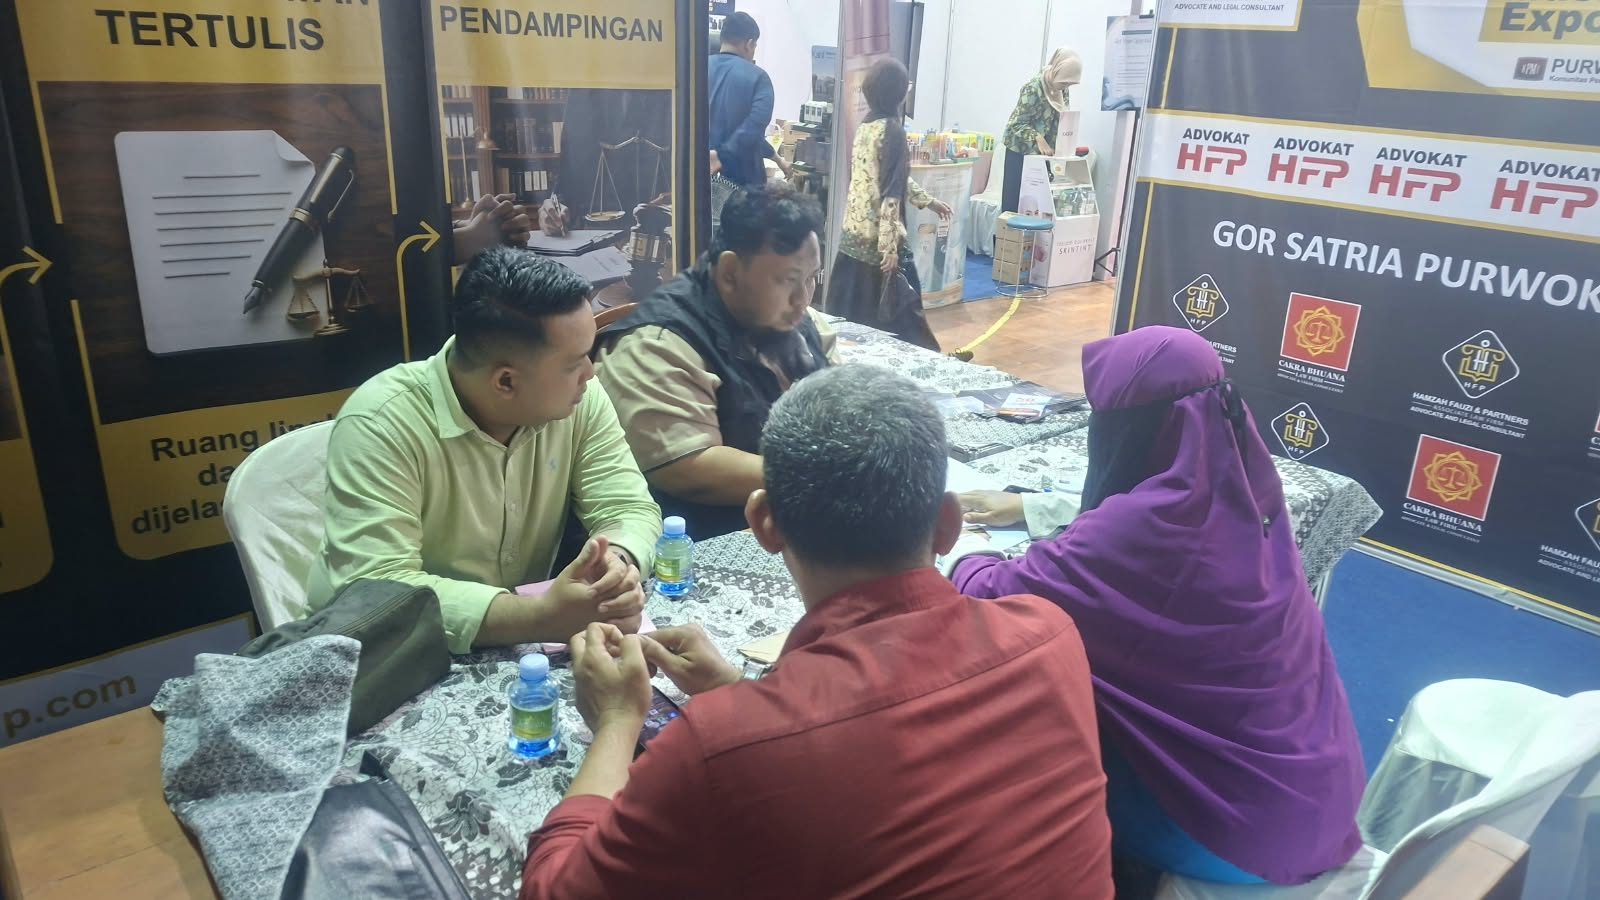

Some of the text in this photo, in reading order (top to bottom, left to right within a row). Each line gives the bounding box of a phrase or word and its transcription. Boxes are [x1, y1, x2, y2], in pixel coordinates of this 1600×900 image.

[95, 9, 324, 50] TERTULIS
[440, 5, 663, 42] PENDAMPINGAN
[1183, 128, 1250, 145] ADVOKAT
[1274, 137, 1354, 156] ADVOKAT
[1176, 143, 1248, 175] HFP
[1267, 153, 1350, 188] HFP
[1376, 147, 1467, 168] ADVOKAT
[1500, 160, 1600, 182] ADVOKAT
[1368, 164, 1461, 202] HFP
[1490, 178, 1599, 219] HFP
[1213, 221, 1600, 313] GOR SATRIA PURWOK
[1207, 340, 1237, 353] ARTNERS
[1278, 359, 1345, 382] CAKRA BHUANA
[1464, 381, 1486, 391] HFP
[1410, 405, 1525, 439] ADVOCATE AND LEGAL CONSULTANT
[1412, 391, 1529, 425] HAMZAH FAUZI & PARTNERS
[151, 429, 260, 461] Ruang
[1288, 445, 1304, 455] HFP
[131, 500, 224, 534] dijela
[1403, 502, 1437, 518] CAKRA
[1438, 512, 1482, 532] BHUANA
[1541, 544, 1580, 562] HAMZAH
[3, 674, 137, 738] p.com
